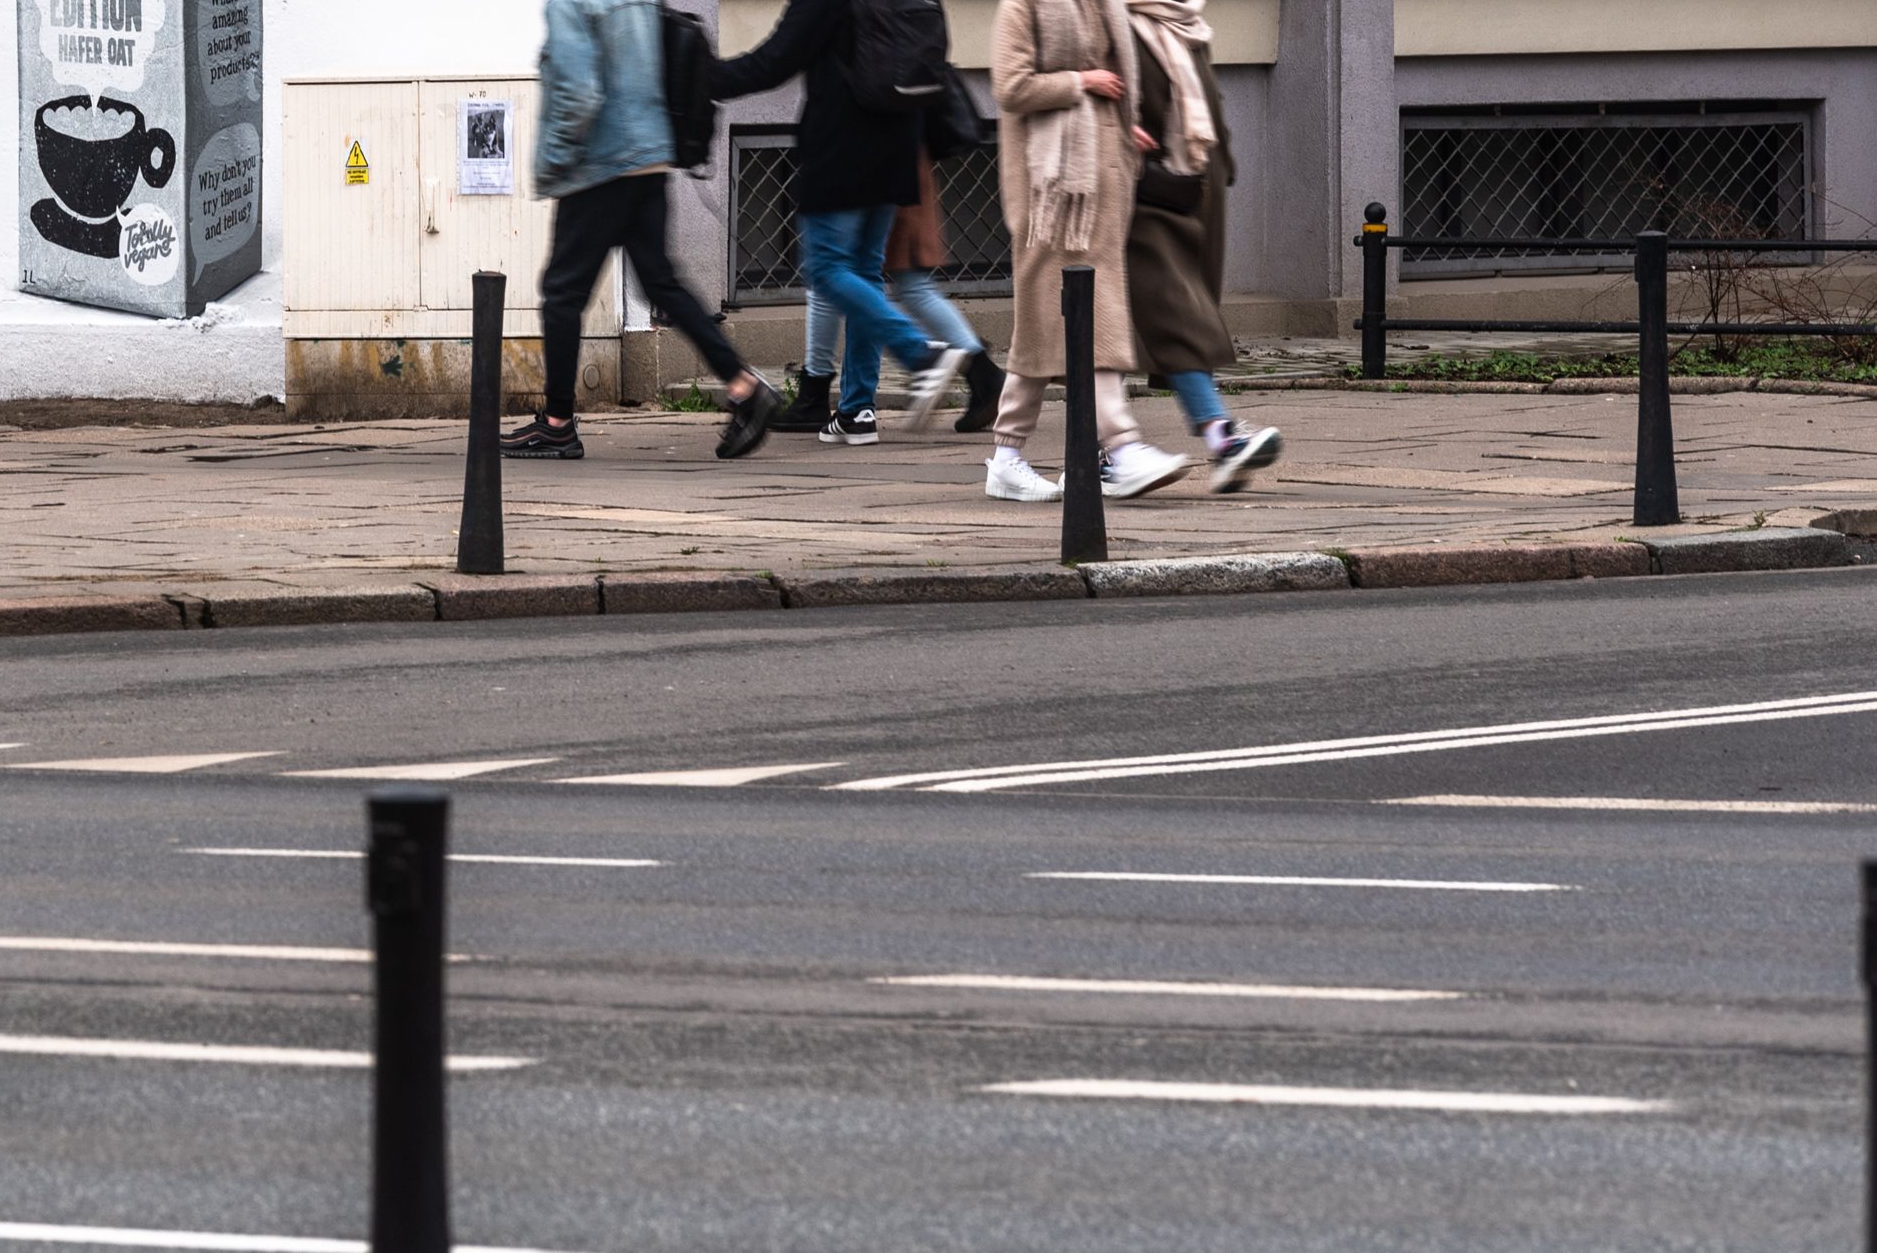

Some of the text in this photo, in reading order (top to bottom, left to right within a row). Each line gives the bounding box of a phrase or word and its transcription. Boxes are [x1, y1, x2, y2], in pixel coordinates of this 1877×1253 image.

[212, 6, 249, 29] amazing
[57, 34, 136, 67] HAFER OAT
[207, 30, 251, 56] about your
[198, 155, 257, 193] Why don't you
[202, 176, 254, 217] try them all
[125, 218, 176, 253] Totally
[205, 201, 252, 241] and tell us?
[124, 243, 173, 273] vegan
